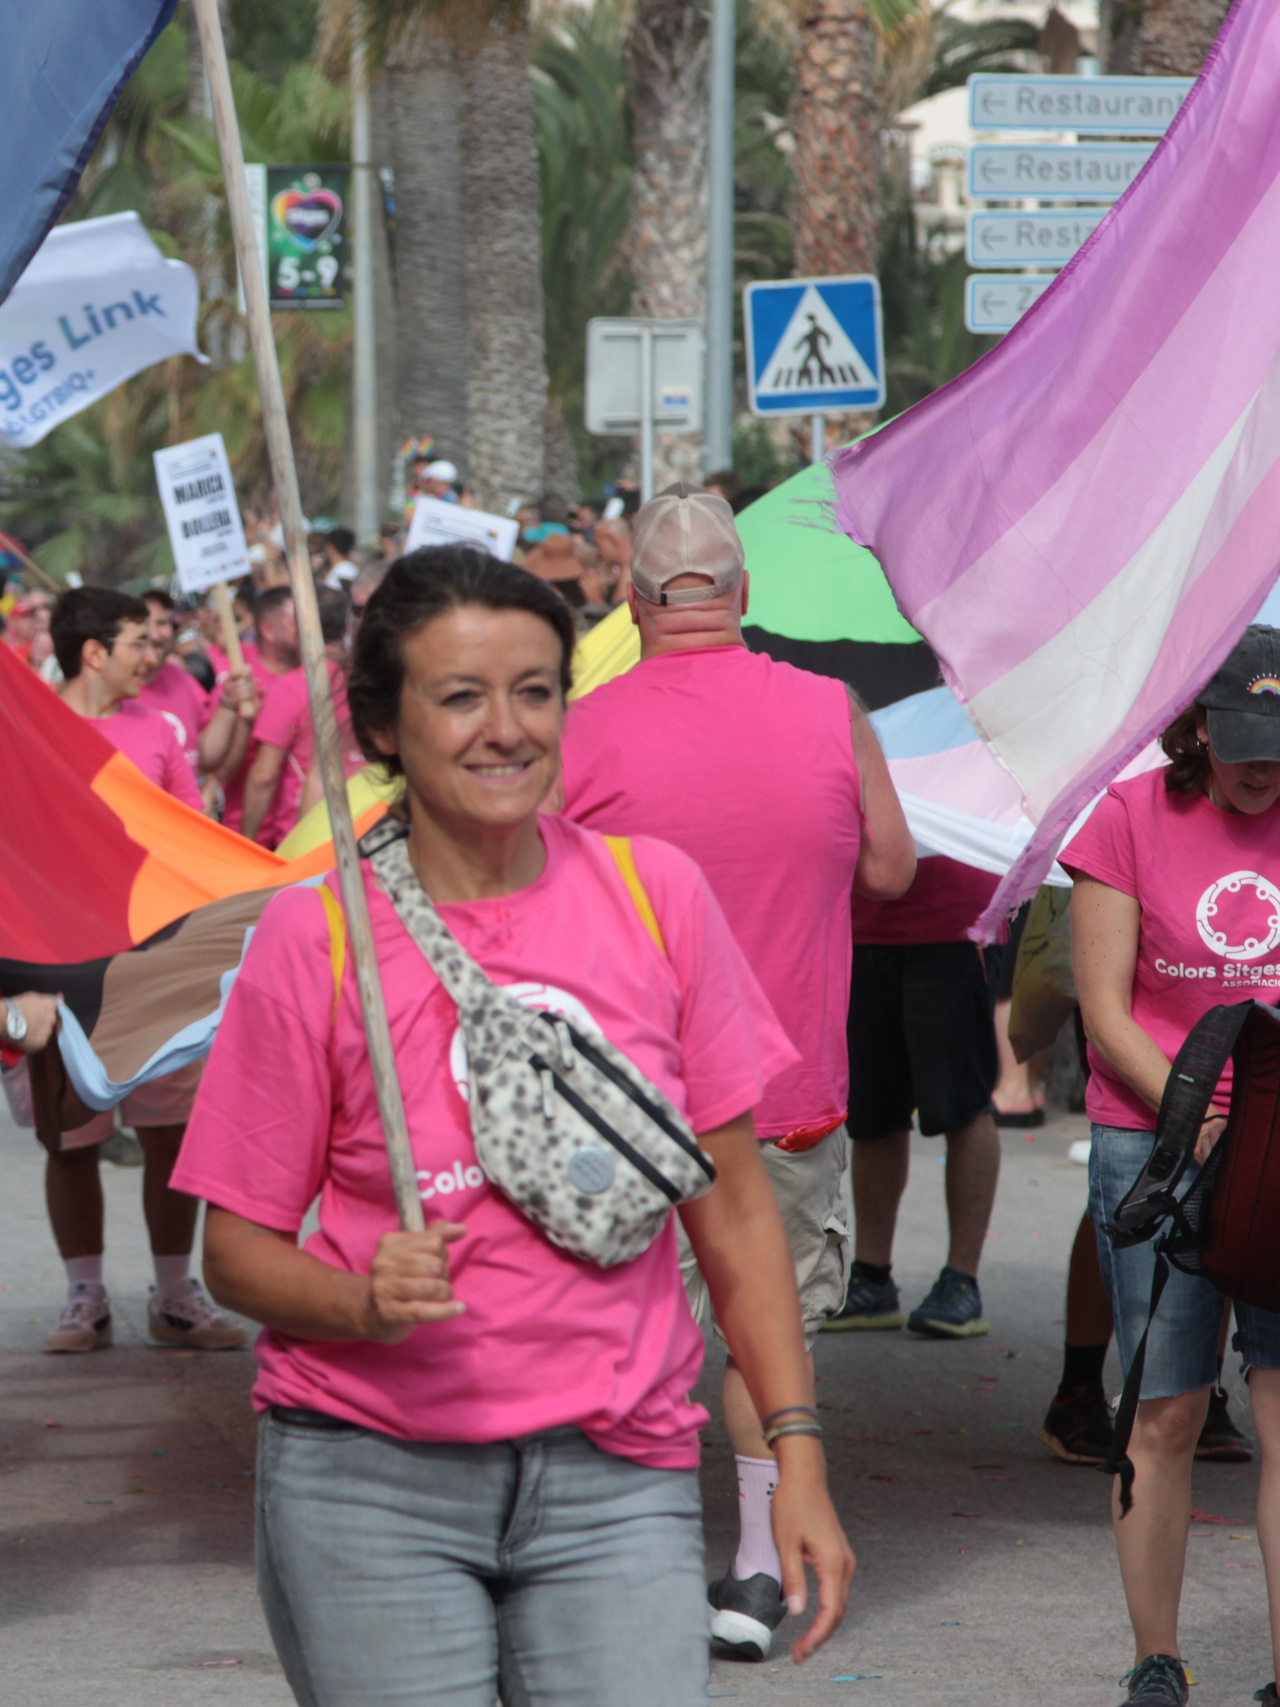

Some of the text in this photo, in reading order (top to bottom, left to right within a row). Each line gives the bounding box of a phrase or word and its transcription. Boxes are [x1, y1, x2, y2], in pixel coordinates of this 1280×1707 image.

[1014, 153, 1141, 183] Restaur
[1014, 220, 1091, 248] Rest
[276, 255, 340, 289] 5-9
[57, 289, 166, 351] Link
[1154, 958, 1217, 979] Colors
